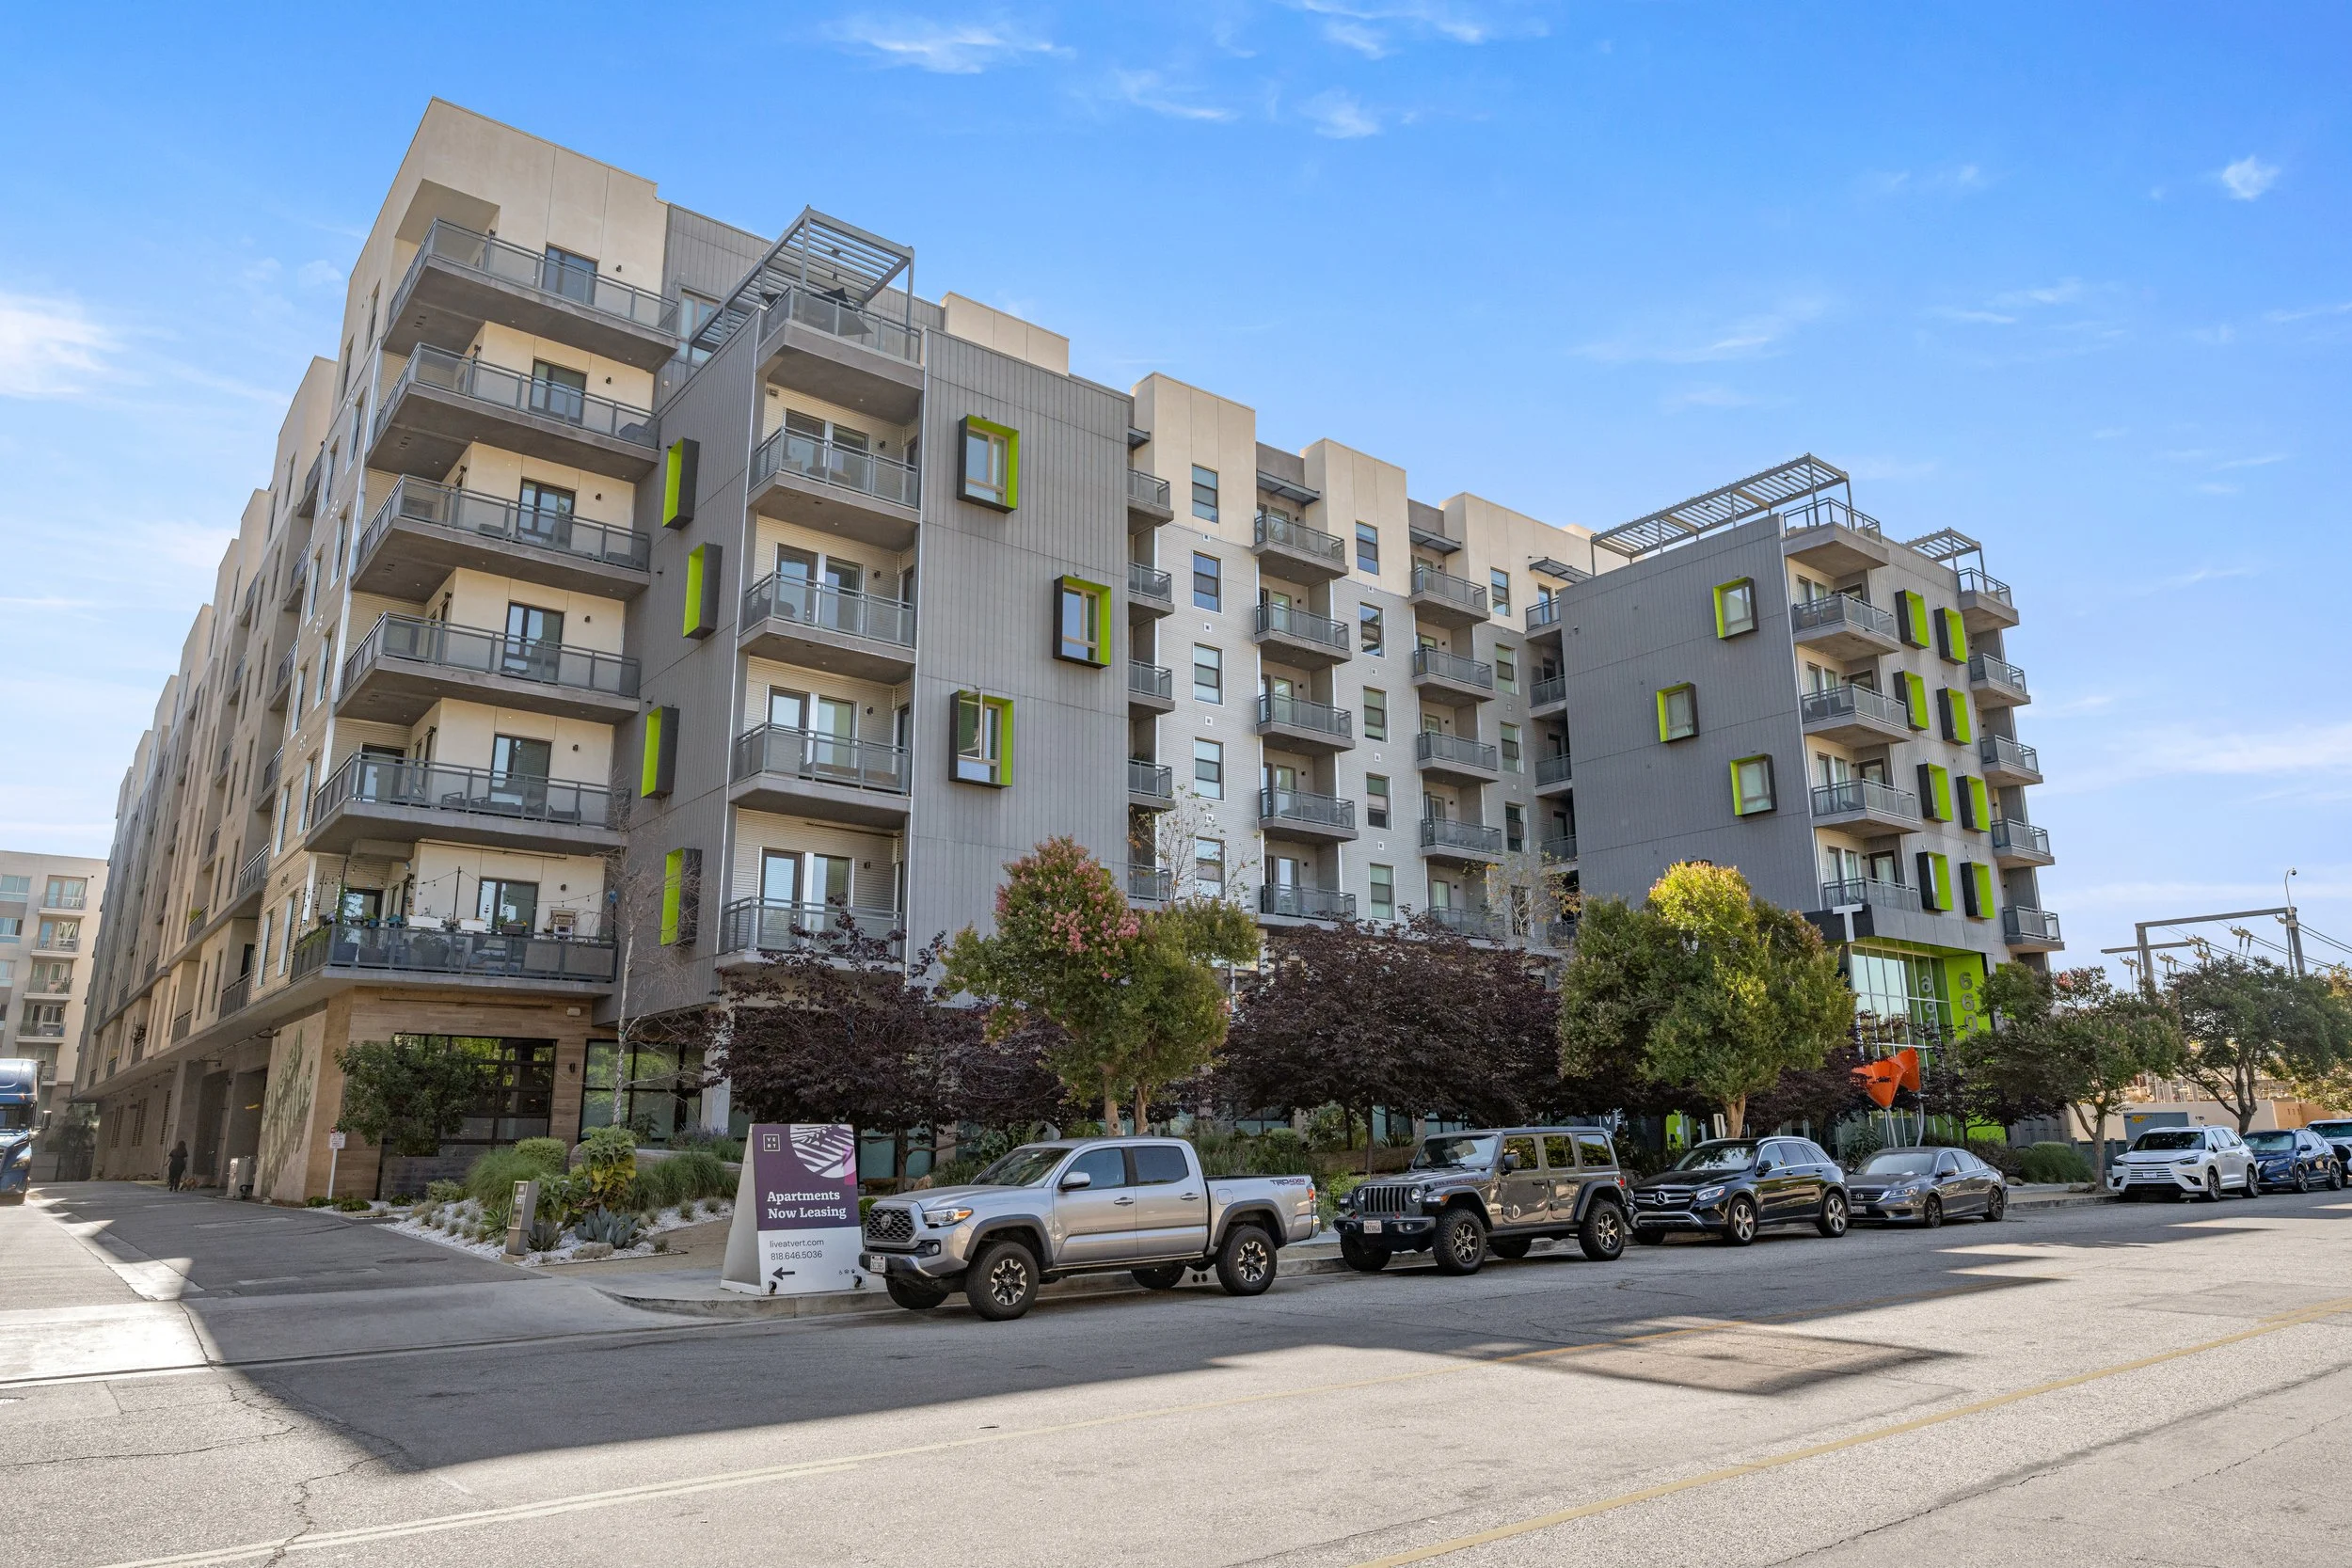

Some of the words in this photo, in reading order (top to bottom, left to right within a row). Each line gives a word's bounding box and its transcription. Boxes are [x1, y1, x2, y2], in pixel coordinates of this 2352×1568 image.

[1434, 1177, 1479, 1187] RUBICON
[767, 1191, 840, 1205] Apartments
[768, 1208, 797, 1219] Now
[799, 1206, 847, 1220] Leasing
[770, 1240, 824, 1248] liveatvert.com
[771, 1250, 823, 1261] 818.646.5036
